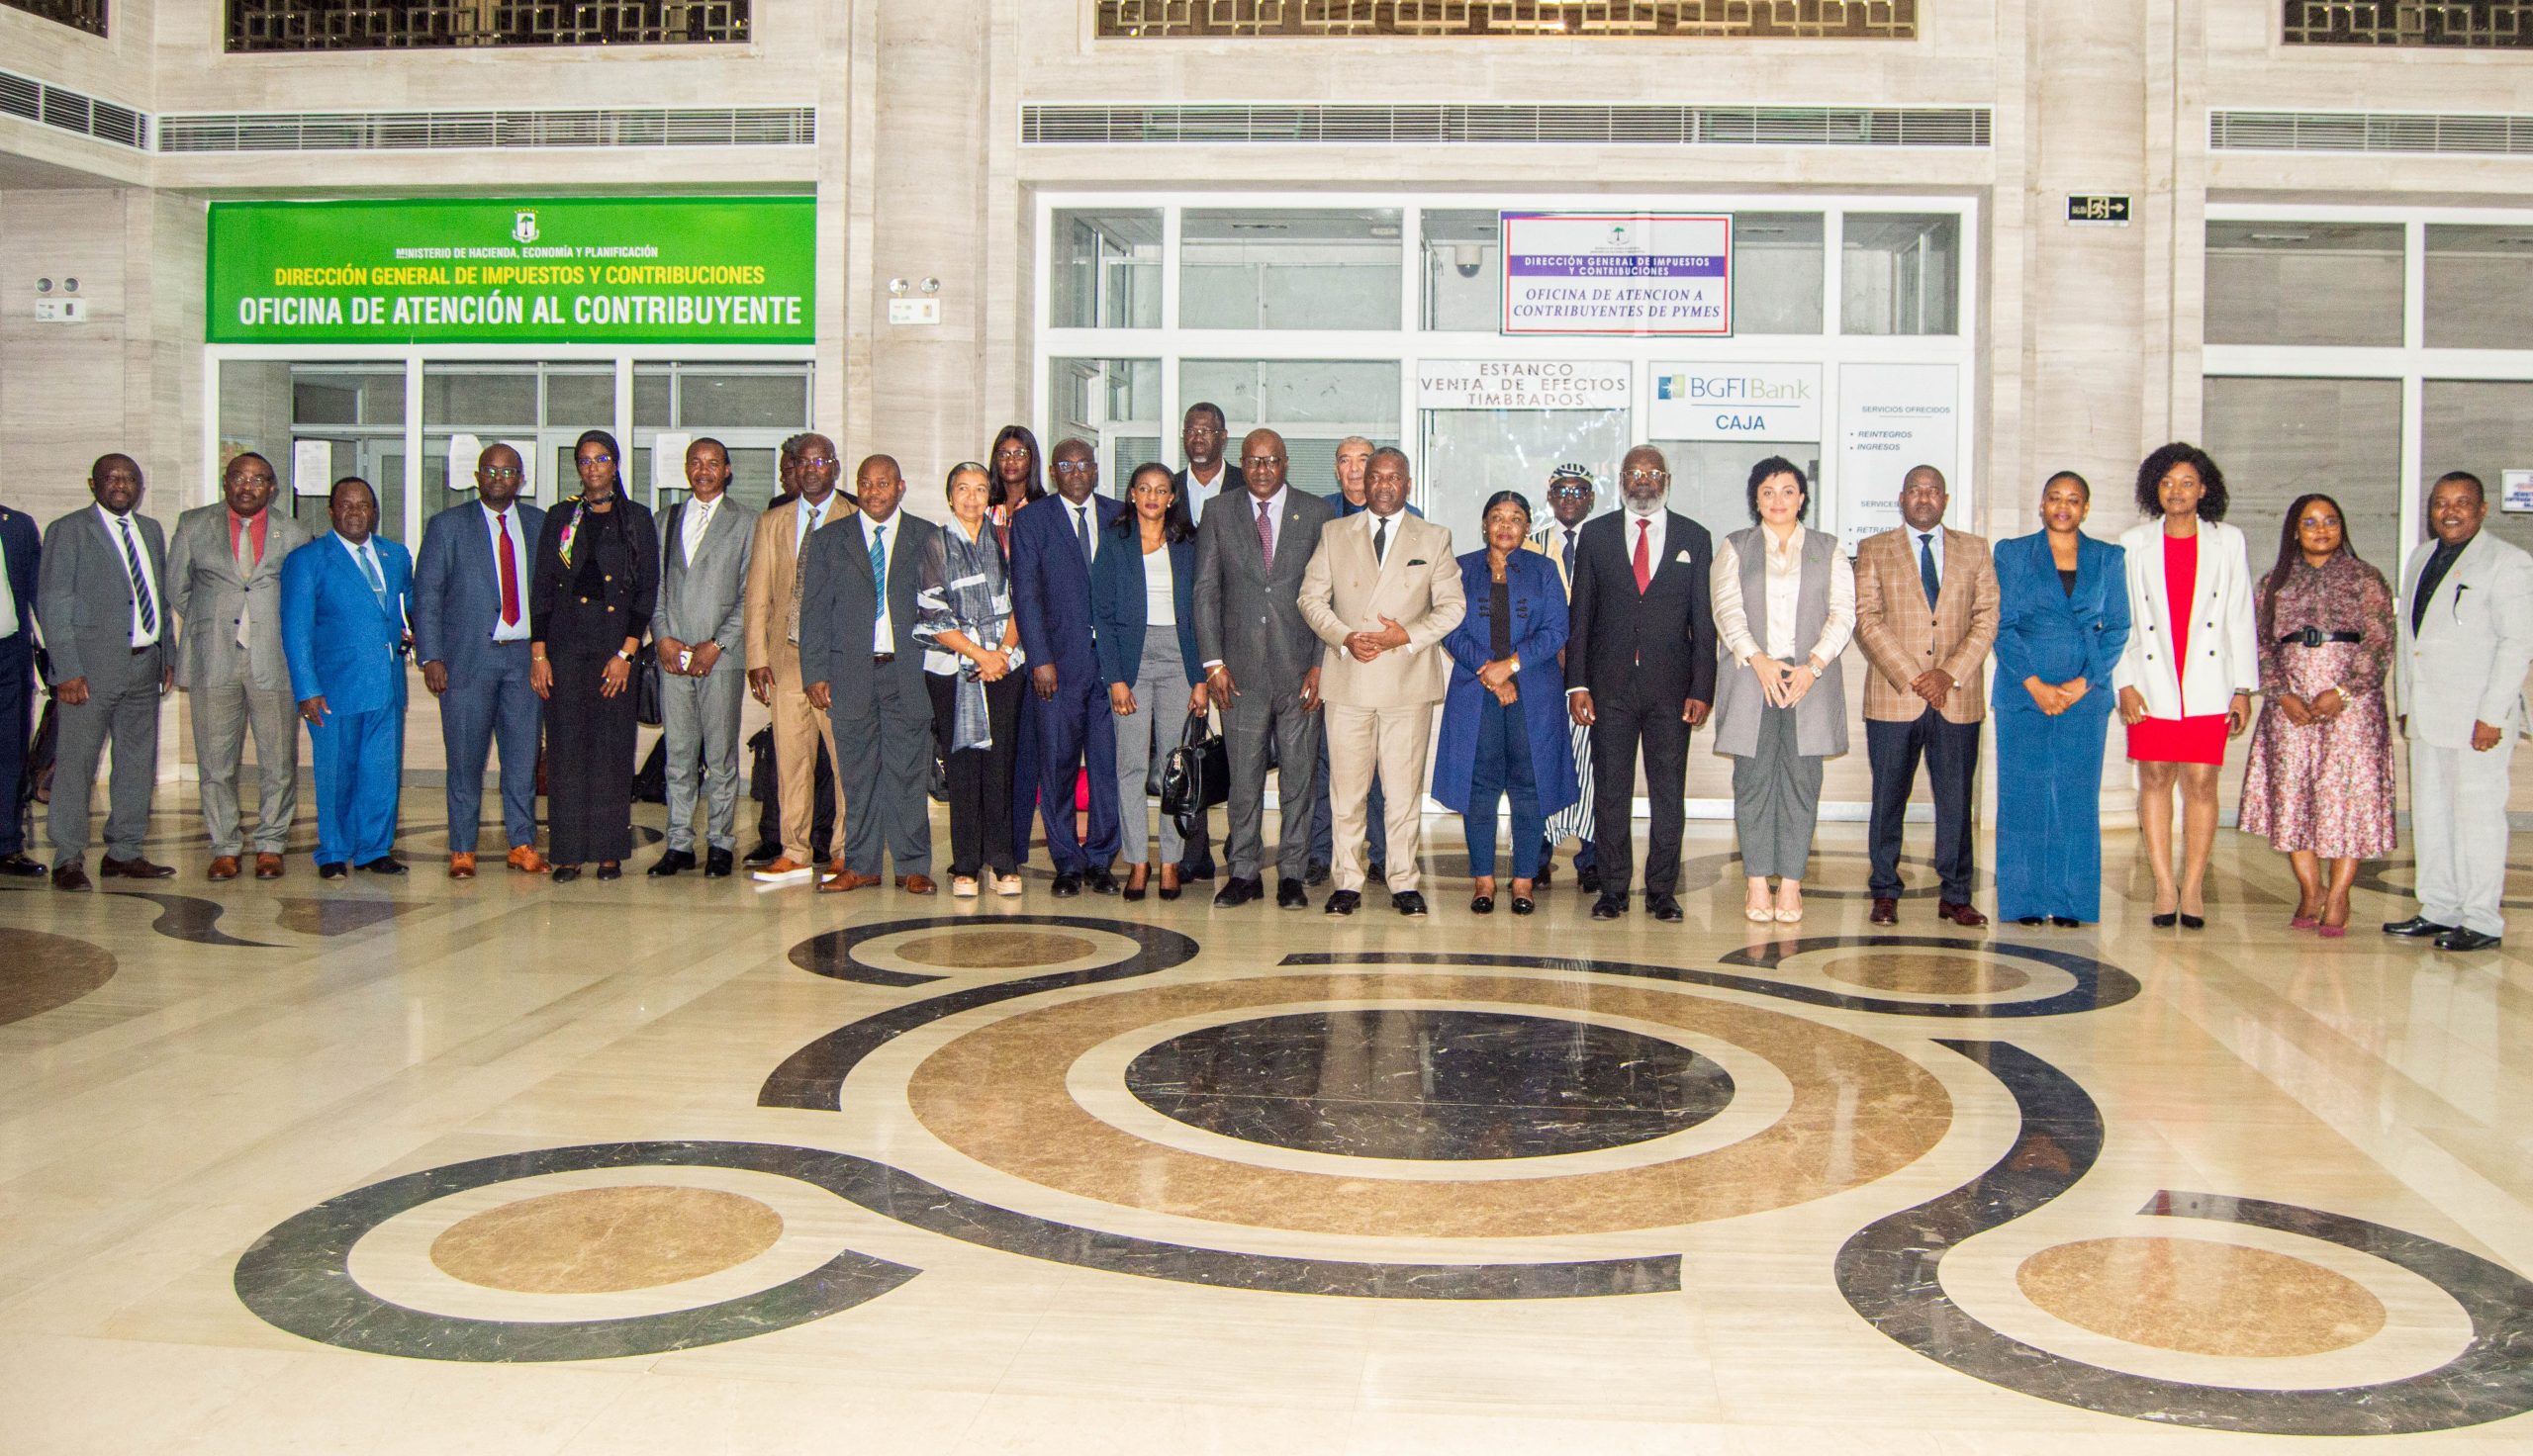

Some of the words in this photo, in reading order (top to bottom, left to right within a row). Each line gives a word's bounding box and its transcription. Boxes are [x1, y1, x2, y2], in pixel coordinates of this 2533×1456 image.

[396, 248, 451, 259] MINISTERIO
[453, 247, 467, 259] DE
[469, 247, 520, 259] HACIENDA,
[522, 244, 574, 258] ECONOMÍA
[576, 247, 583, 258] Y
[585, 244, 658, 257] PLANIFICACIÓN
[1525, 255, 1583, 266] DIRECCIÓN
[1587, 257, 1634, 266] GENERAL
[1638, 257, 1650, 266] DE
[1653, 257, 1710, 266] IMPUESTOS
[275, 263, 367, 286] DIRECCIÓN
[371, 267, 449, 285] GENERAL
[454, 266, 477, 285] DE
[482, 266, 585, 285] IMPUESTOS
[589, 266, 602, 284] Y
[606, 266, 765, 284] CONTRIBUCIONES
[1568, 267, 1575, 276] Y
[1579, 267, 1669, 276] CONTRIBUCIONES
[1526, 289, 1586, 301] OFICINA
[1592, 289, 1612, 301] DE
[1616, 289, 1690, 301] ATENCION
[1694, 289, 1704, 301] A
[239, 297, 343, 324] OFICINA
[351, 297, 385, 324] DE
[392, 290, 522, 324] ATENCIÓN
[531, 296, 566, 324] AL
[574, 296, 801, 324] CONTRIBUYENTE
[1514, 305, 1643, 318] CONTRIBUYENTES
[1648, 306, 1667, 318] DE
[1672, 306, 1721, 318] PYMES
[1480, 363, 1573, 376] ESTANCO
[1421, 378, 1484, 391] VENTA
[1501, 379, 1525, 391] DE
[1541, 378, 1626, 392] EFECTOS
[1468, 393, 1584, 406] TIMBRADOS
[1716, 414, 1765, 430] CAJA
